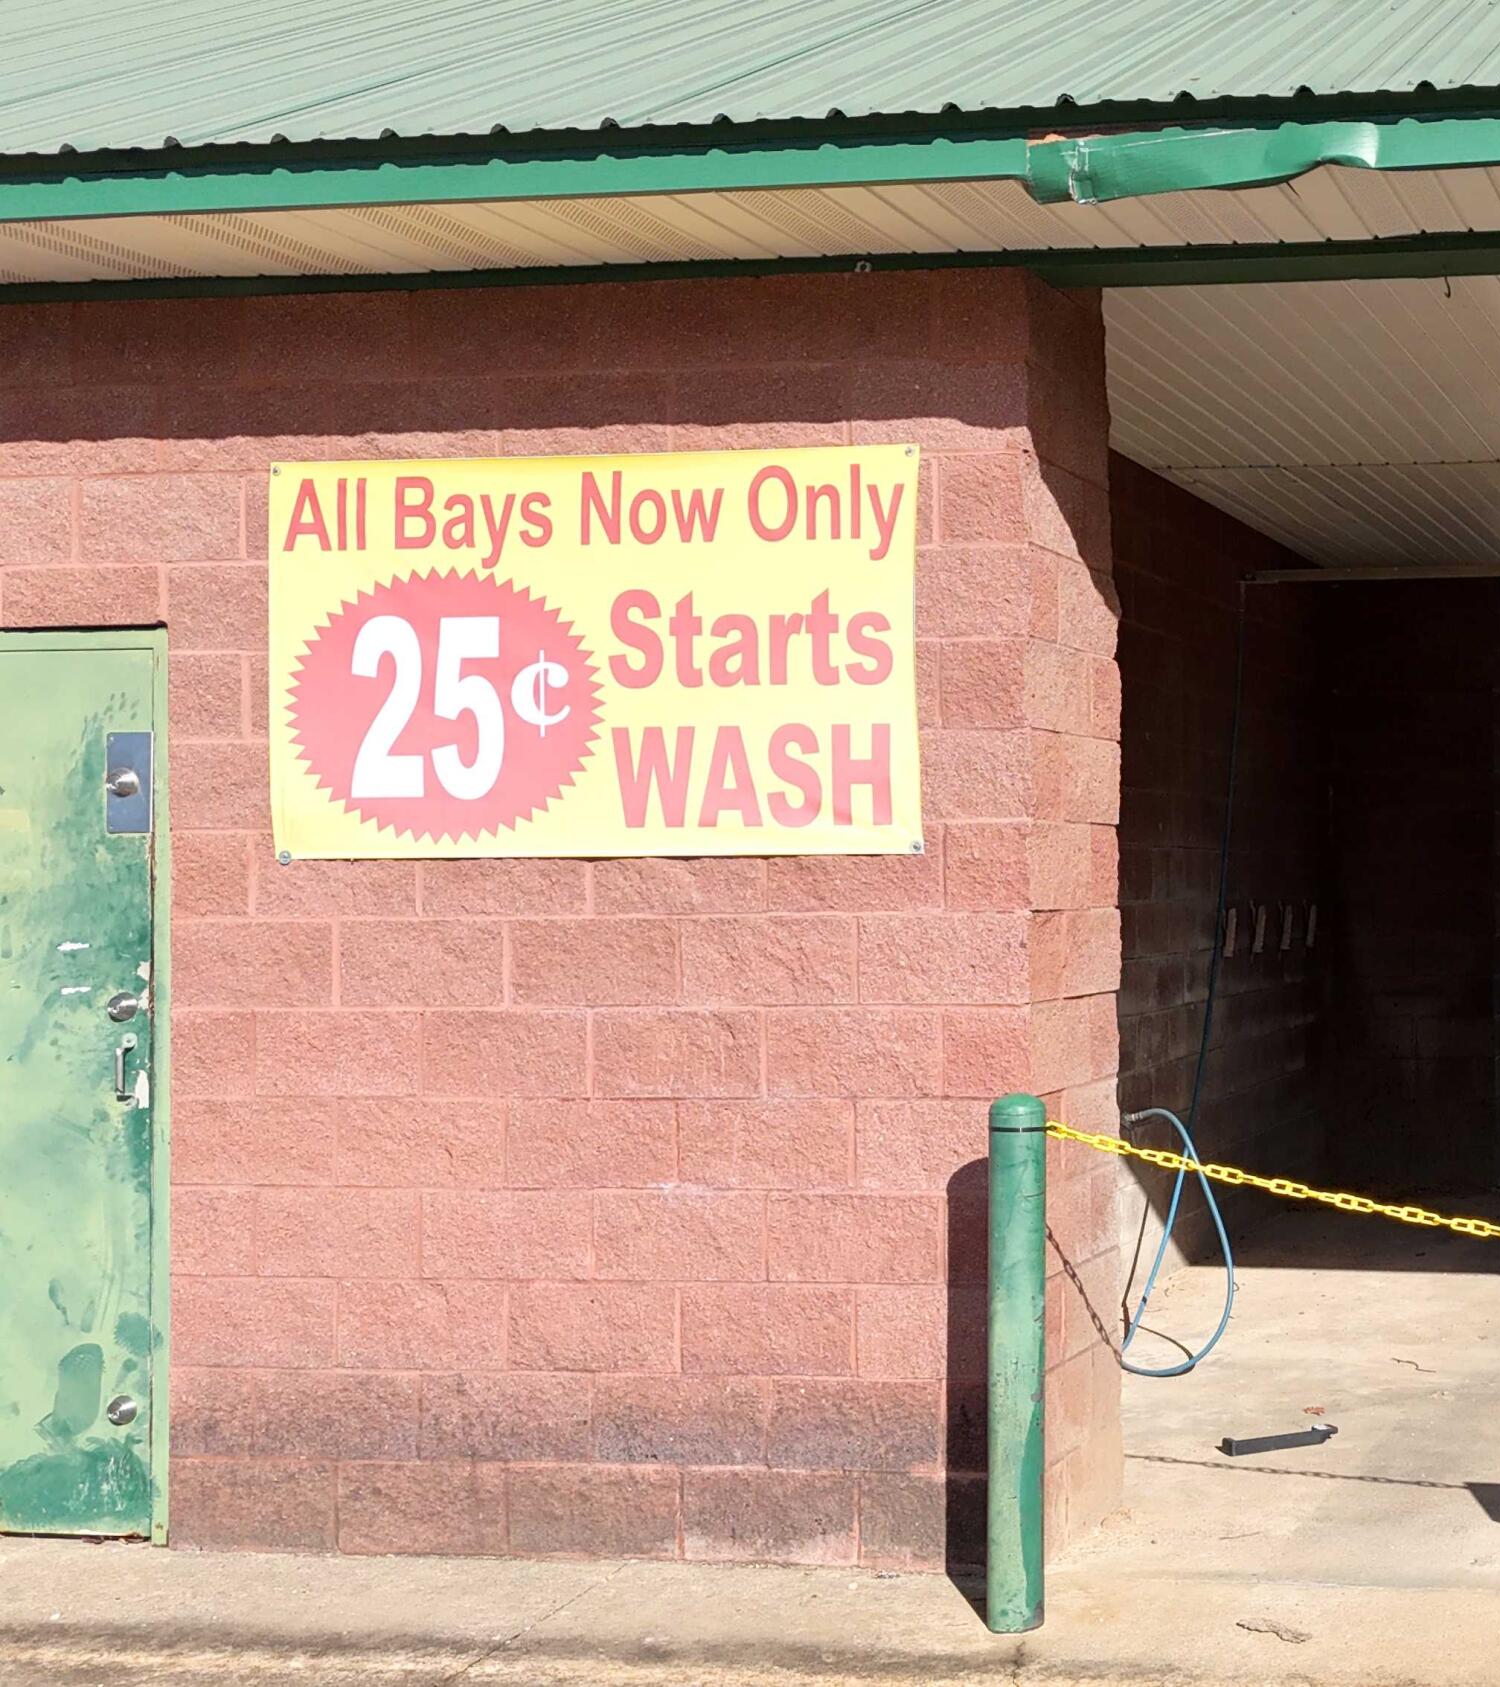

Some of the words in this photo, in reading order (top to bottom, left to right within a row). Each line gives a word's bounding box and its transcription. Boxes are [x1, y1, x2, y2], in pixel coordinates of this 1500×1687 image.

[283, 477, 367, 552] All
[394, 475, 553, 569] Bays
[580, 470, 725, 545] Now
[747, 463, 905, 561] Only
[608, 587, 893, 688] Starts
[612, 723, 892, 828] WASH
